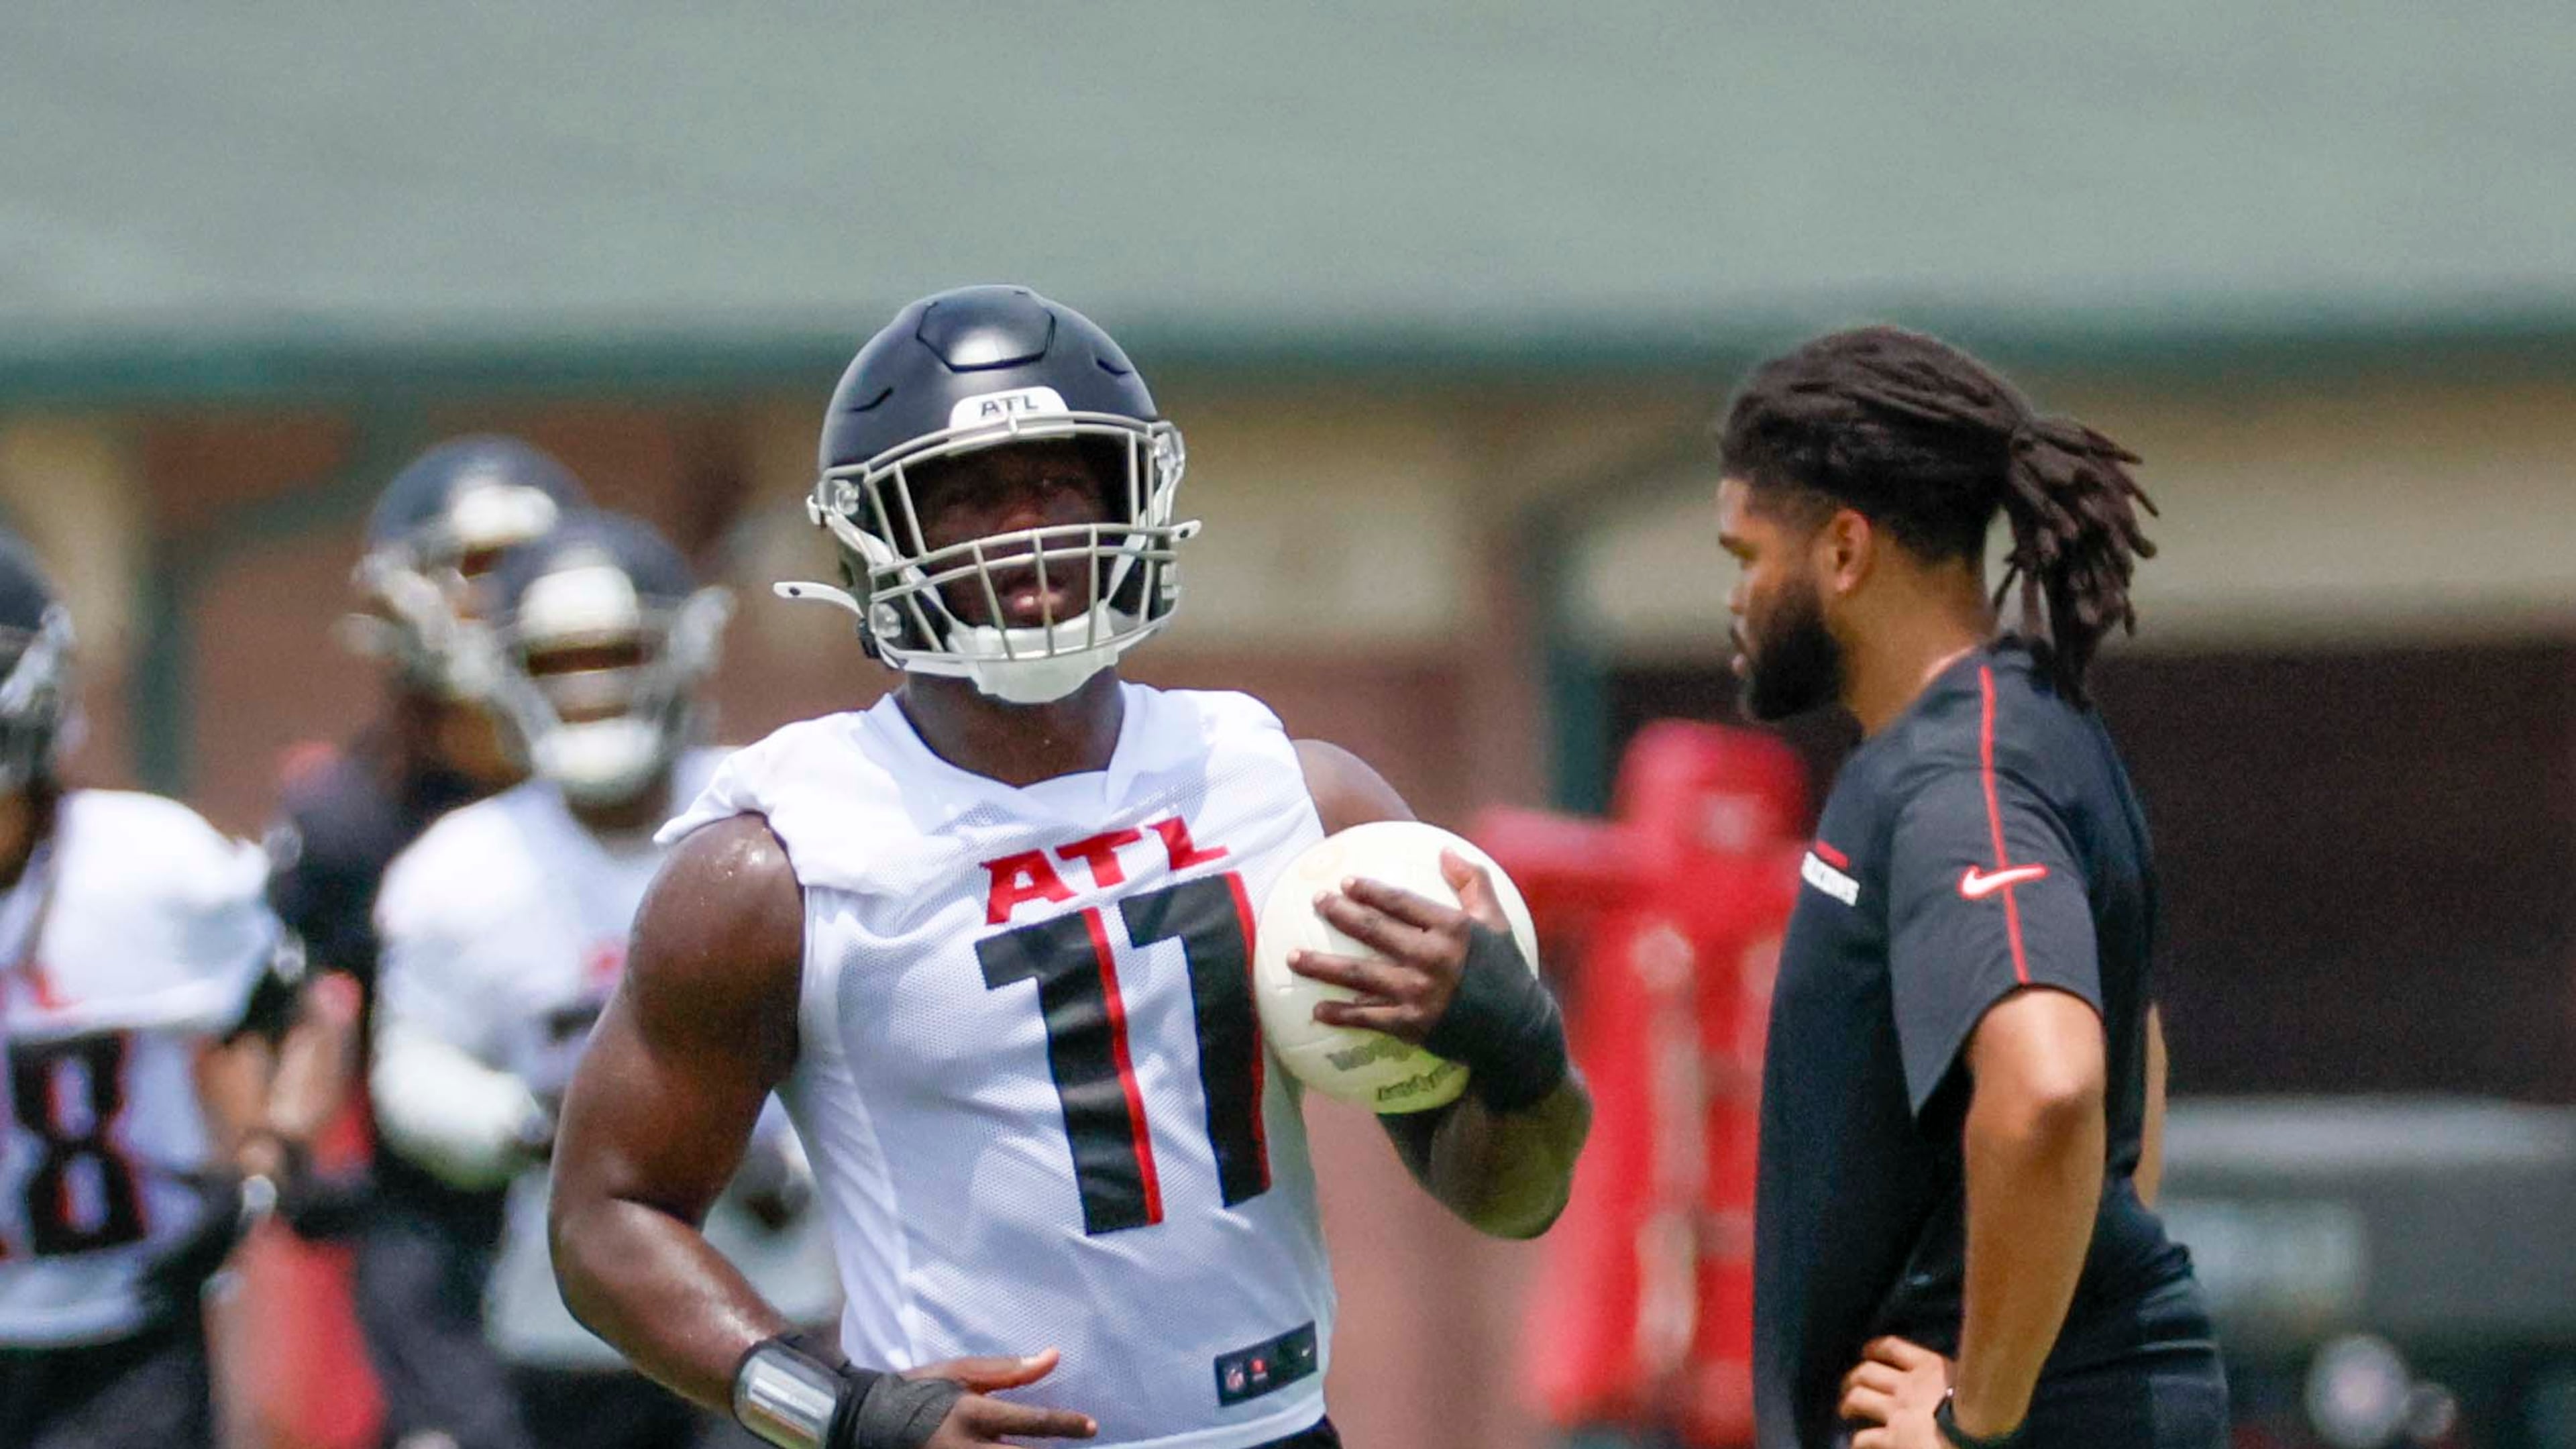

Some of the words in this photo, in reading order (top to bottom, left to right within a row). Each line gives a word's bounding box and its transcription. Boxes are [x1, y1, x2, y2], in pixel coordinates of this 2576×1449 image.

[980, 395, 1039, 417] ATL
[979, 816, 1231, 926] ATL
[974, 870, 1272, 1236] 11
[0, 1026, 146, 1257] 8
